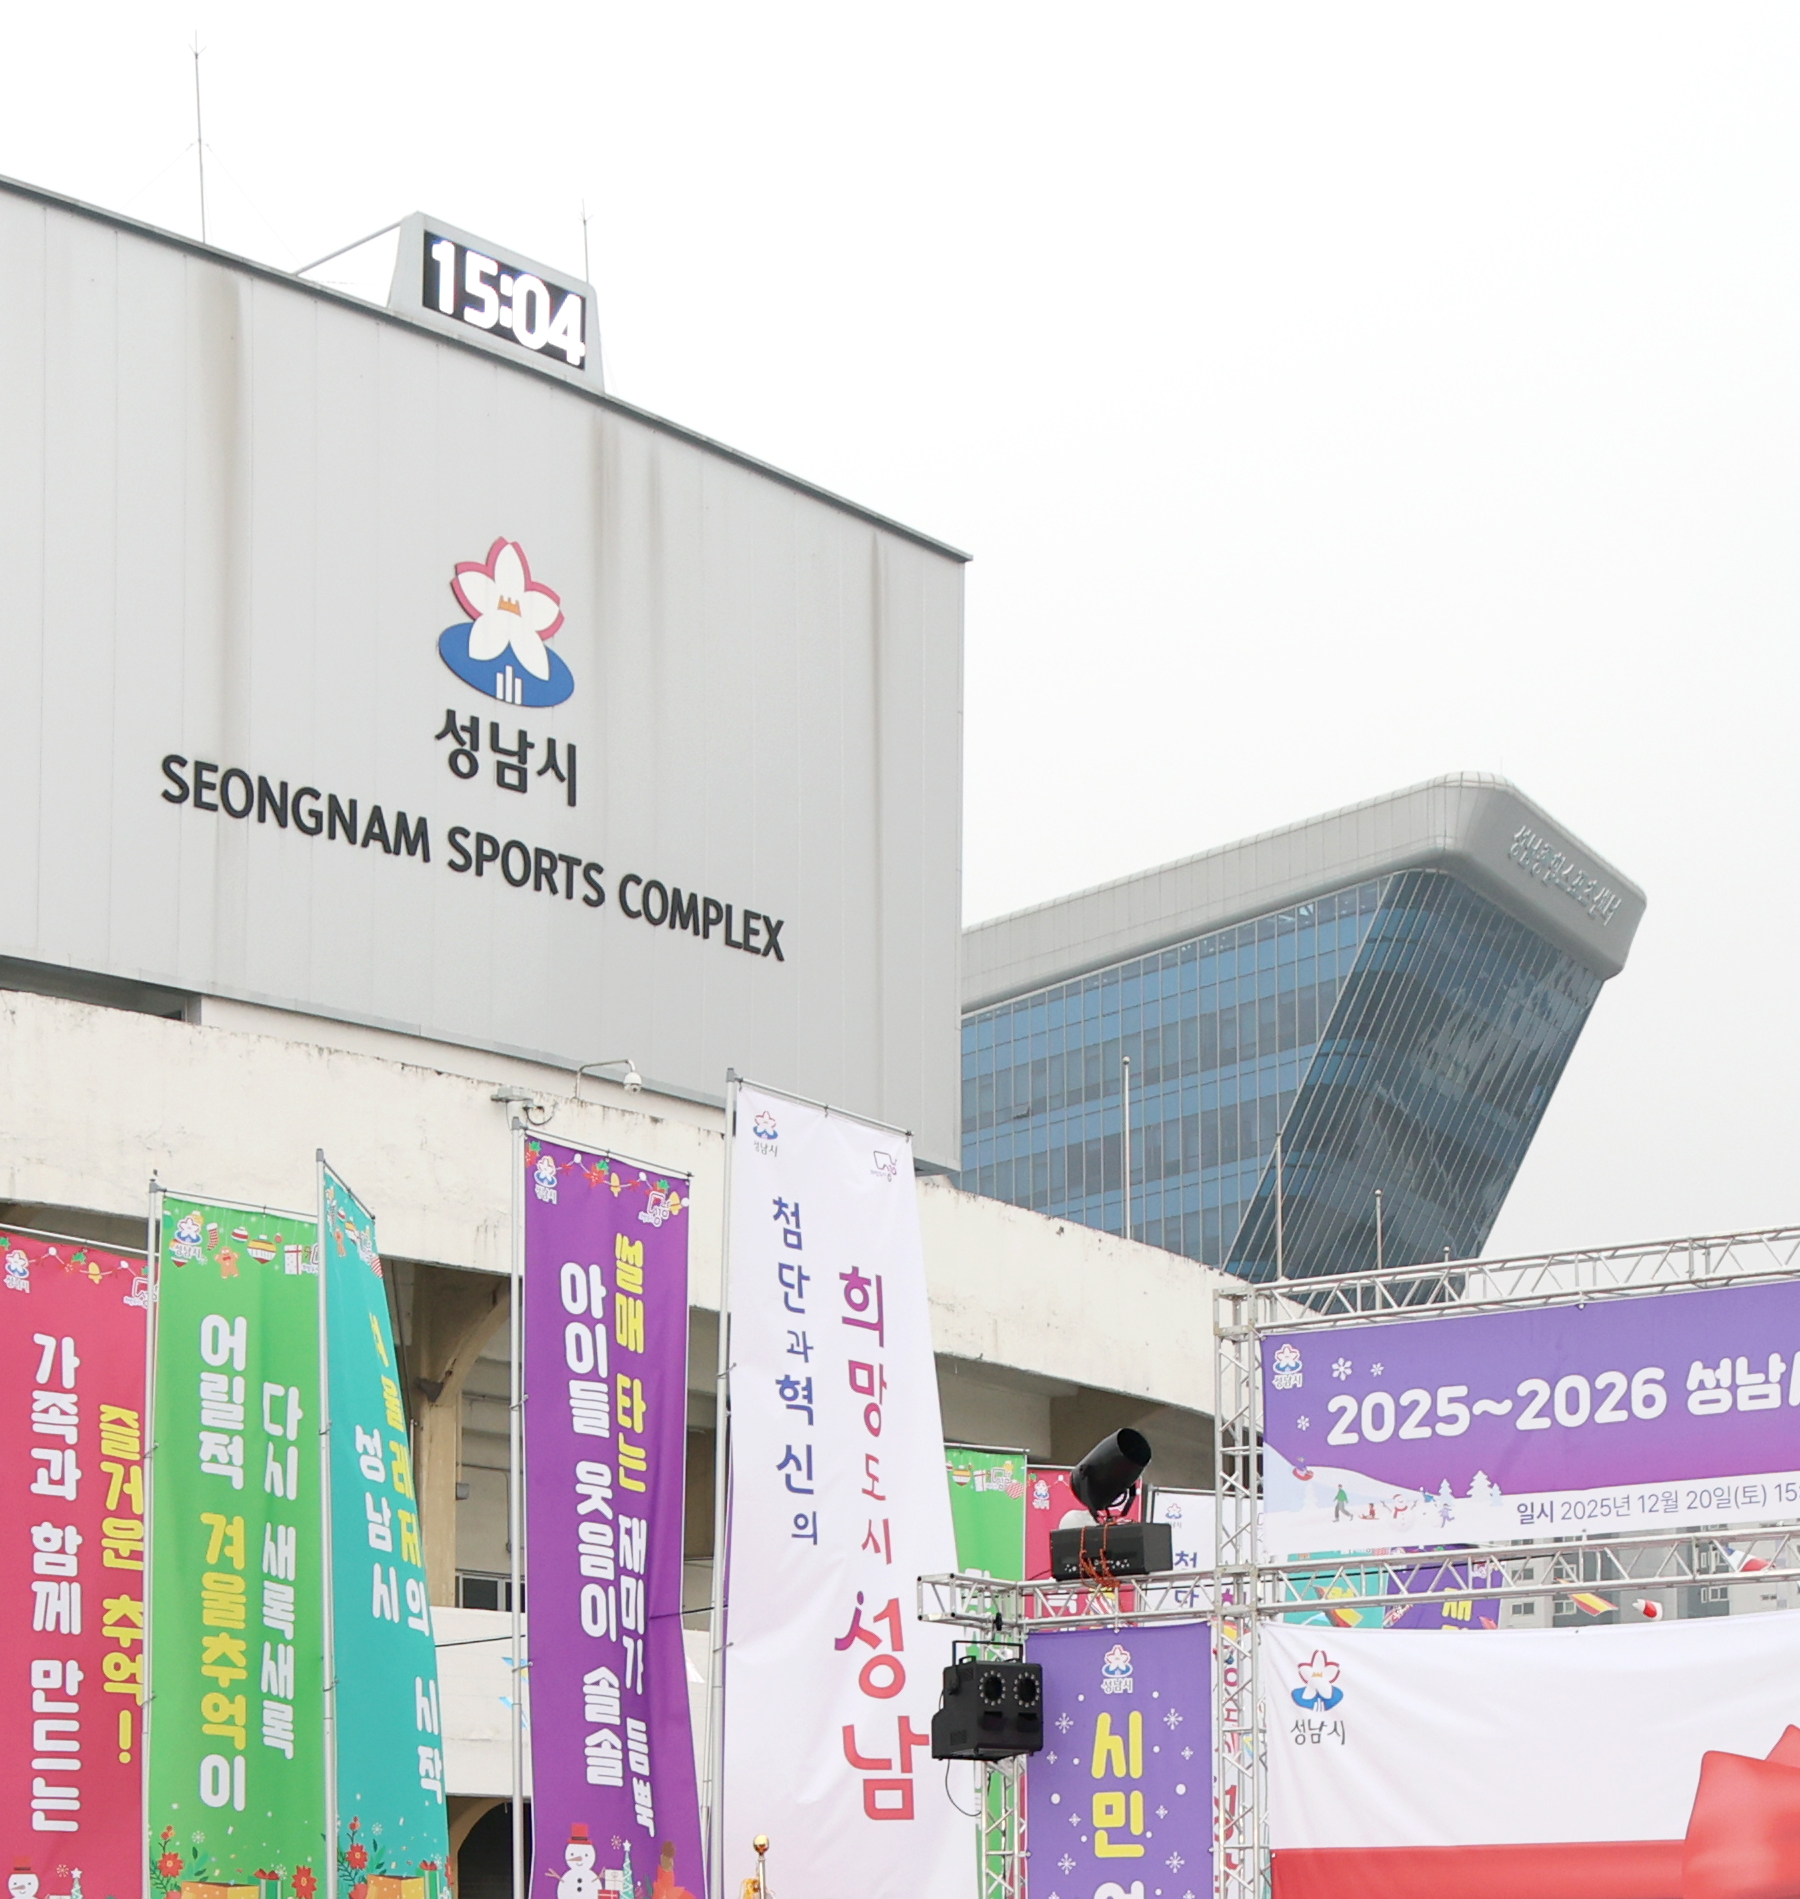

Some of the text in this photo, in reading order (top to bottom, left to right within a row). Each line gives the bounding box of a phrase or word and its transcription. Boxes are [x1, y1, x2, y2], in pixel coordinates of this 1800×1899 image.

[429, 240, 586, 366] 15:04
[434, 707, 578, 807] 성남시
[160, 752, 785, 963] SEONGNAM SPORTS COMPLEX
[1272, 1373, 1302, 1389] 성남시
[1327, 1367, 1667, 1446] 2025~2026
[30, 1333, 85, 1832] 가족과 함께 만드는
[99, 1404, 144, 1764] 즐거운 추억!
[198, 1314, 248, 1812] 어릴적 겨울추억이
[260, 1381, 303, 1760] 다시 새록새록
[354, 1424, 400, 1624] 성남시
[559, 1261, 624, 1788] 아이들 웃음이 솔솔
[614, 1233, 656, 1838] 썰매 타는 재미가 듬뿍
[834, 1265, 930, 1821] 희망도시 성남
[1516, 1502, 1555, 1525] 일시
[1561, 1494, 1630, 1521] 2025년
[1637, 1490, 1681, 1515] 12월
[1686, 1484, 1768, 1511] 20일(토)
[415, 1676, 443, 1805] 시작
[1100, 1678, 1133, 1694] 성남시
[1290, 1718, 1347, 1746] 성남시
[1091, 1710, 1145, 1859] 시민
